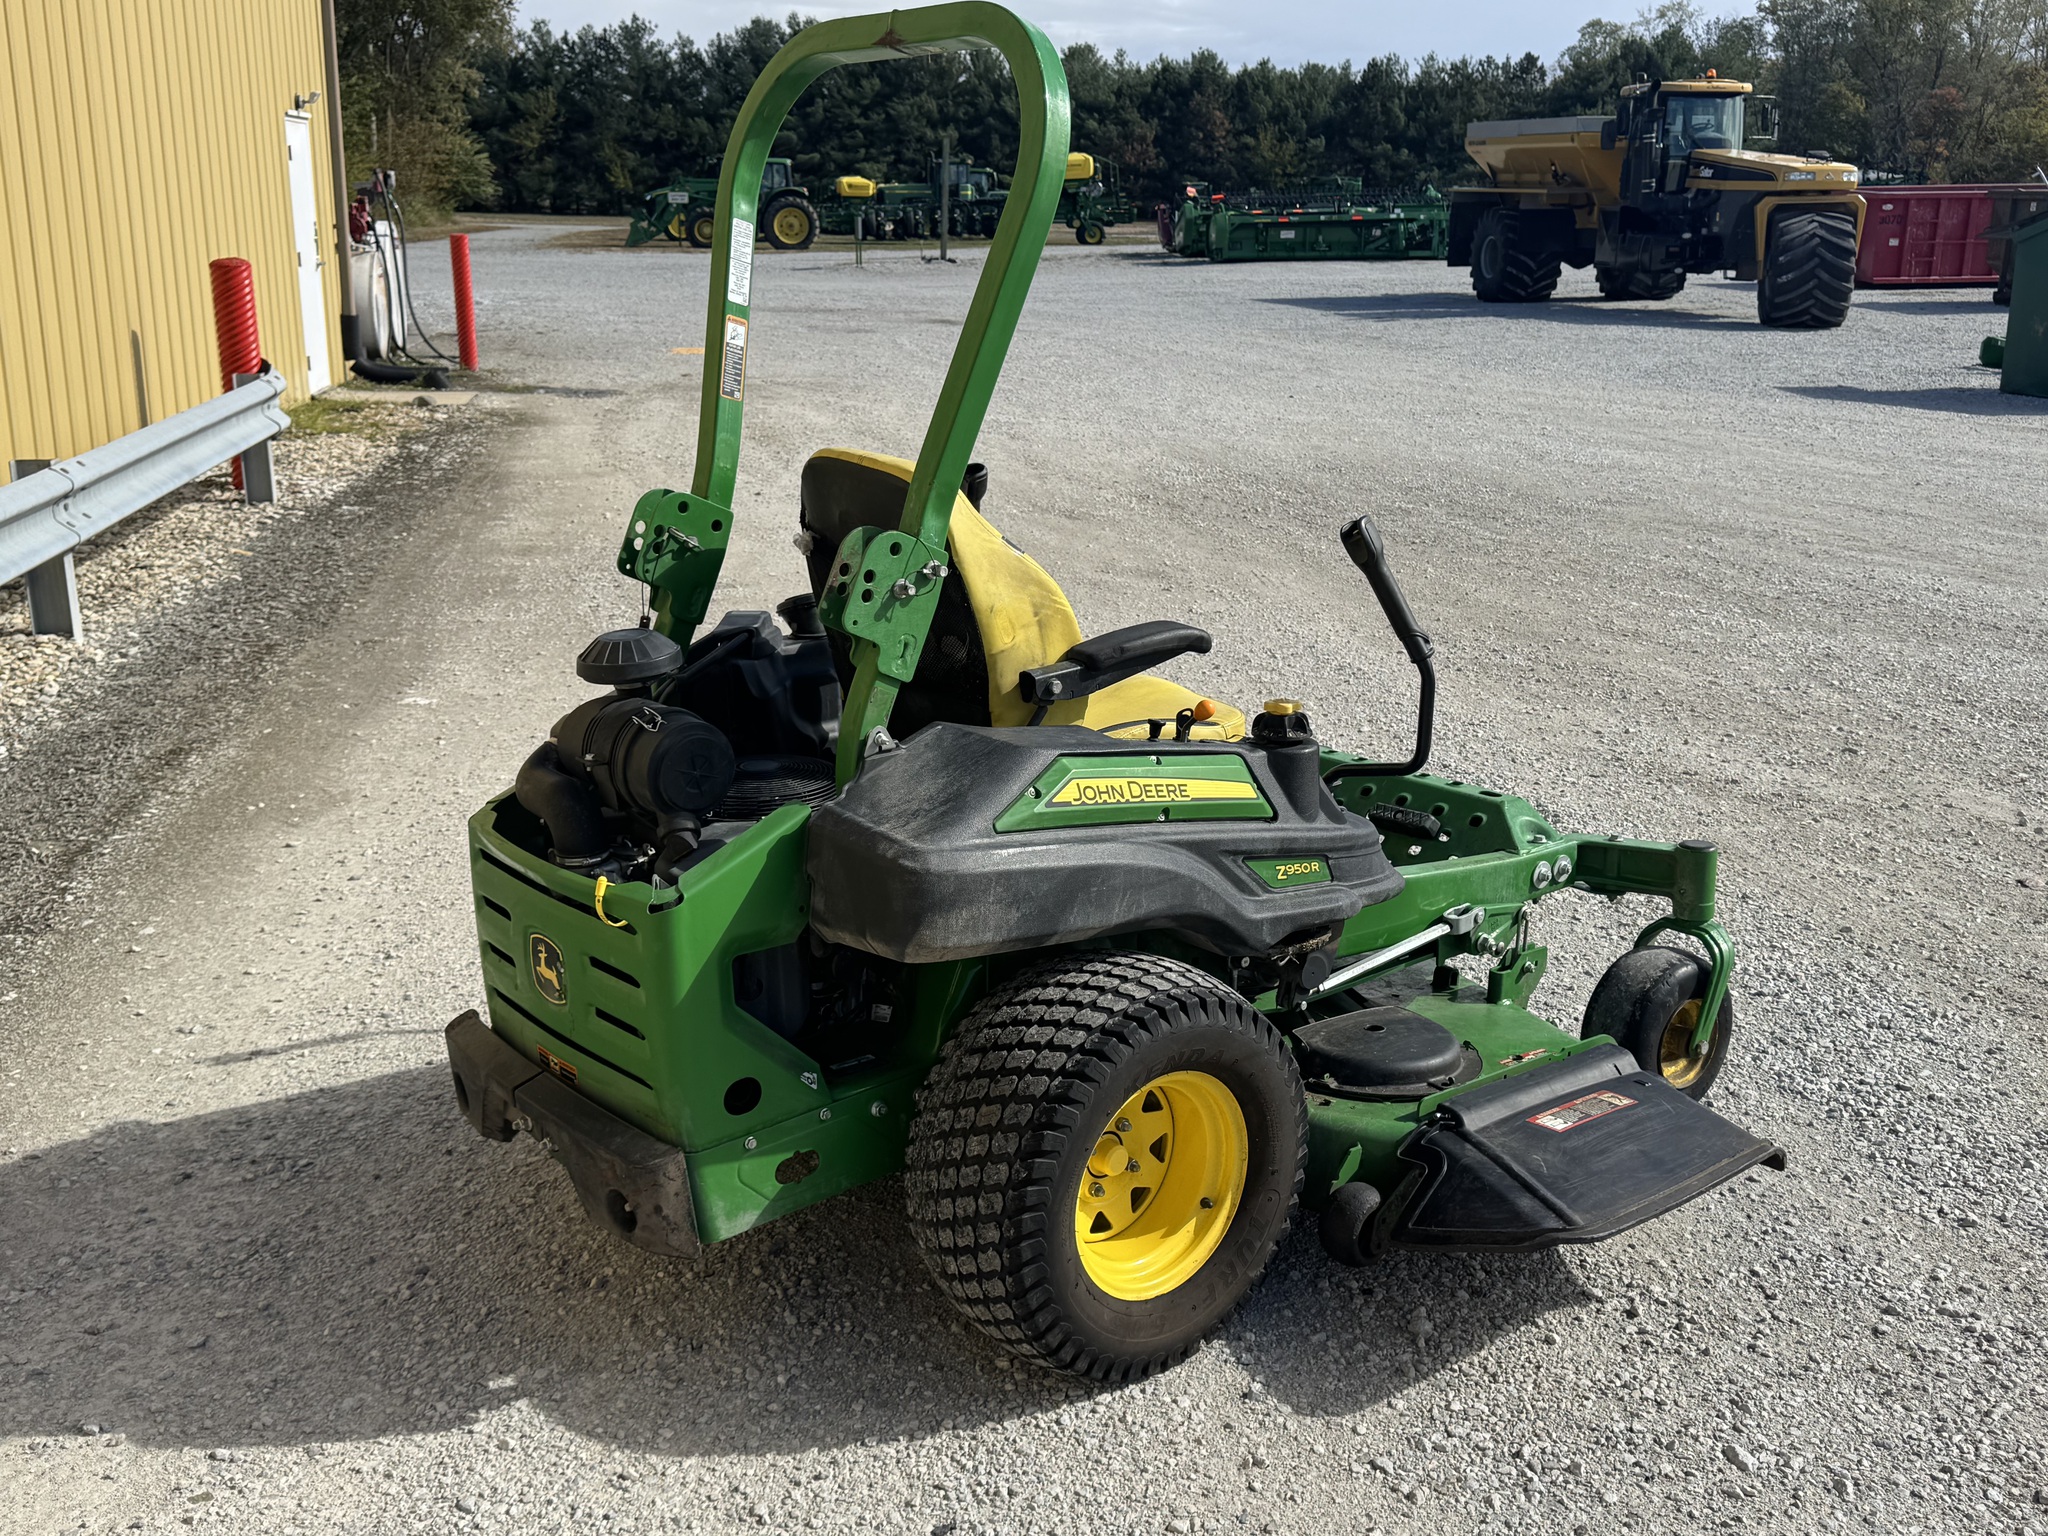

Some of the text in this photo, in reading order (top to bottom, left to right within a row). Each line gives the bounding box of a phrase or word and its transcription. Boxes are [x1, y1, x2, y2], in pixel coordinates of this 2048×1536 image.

[1072, 780, 1191, 802] JOHN DEERE
[1275, 861, 1320, 880] Z950R
